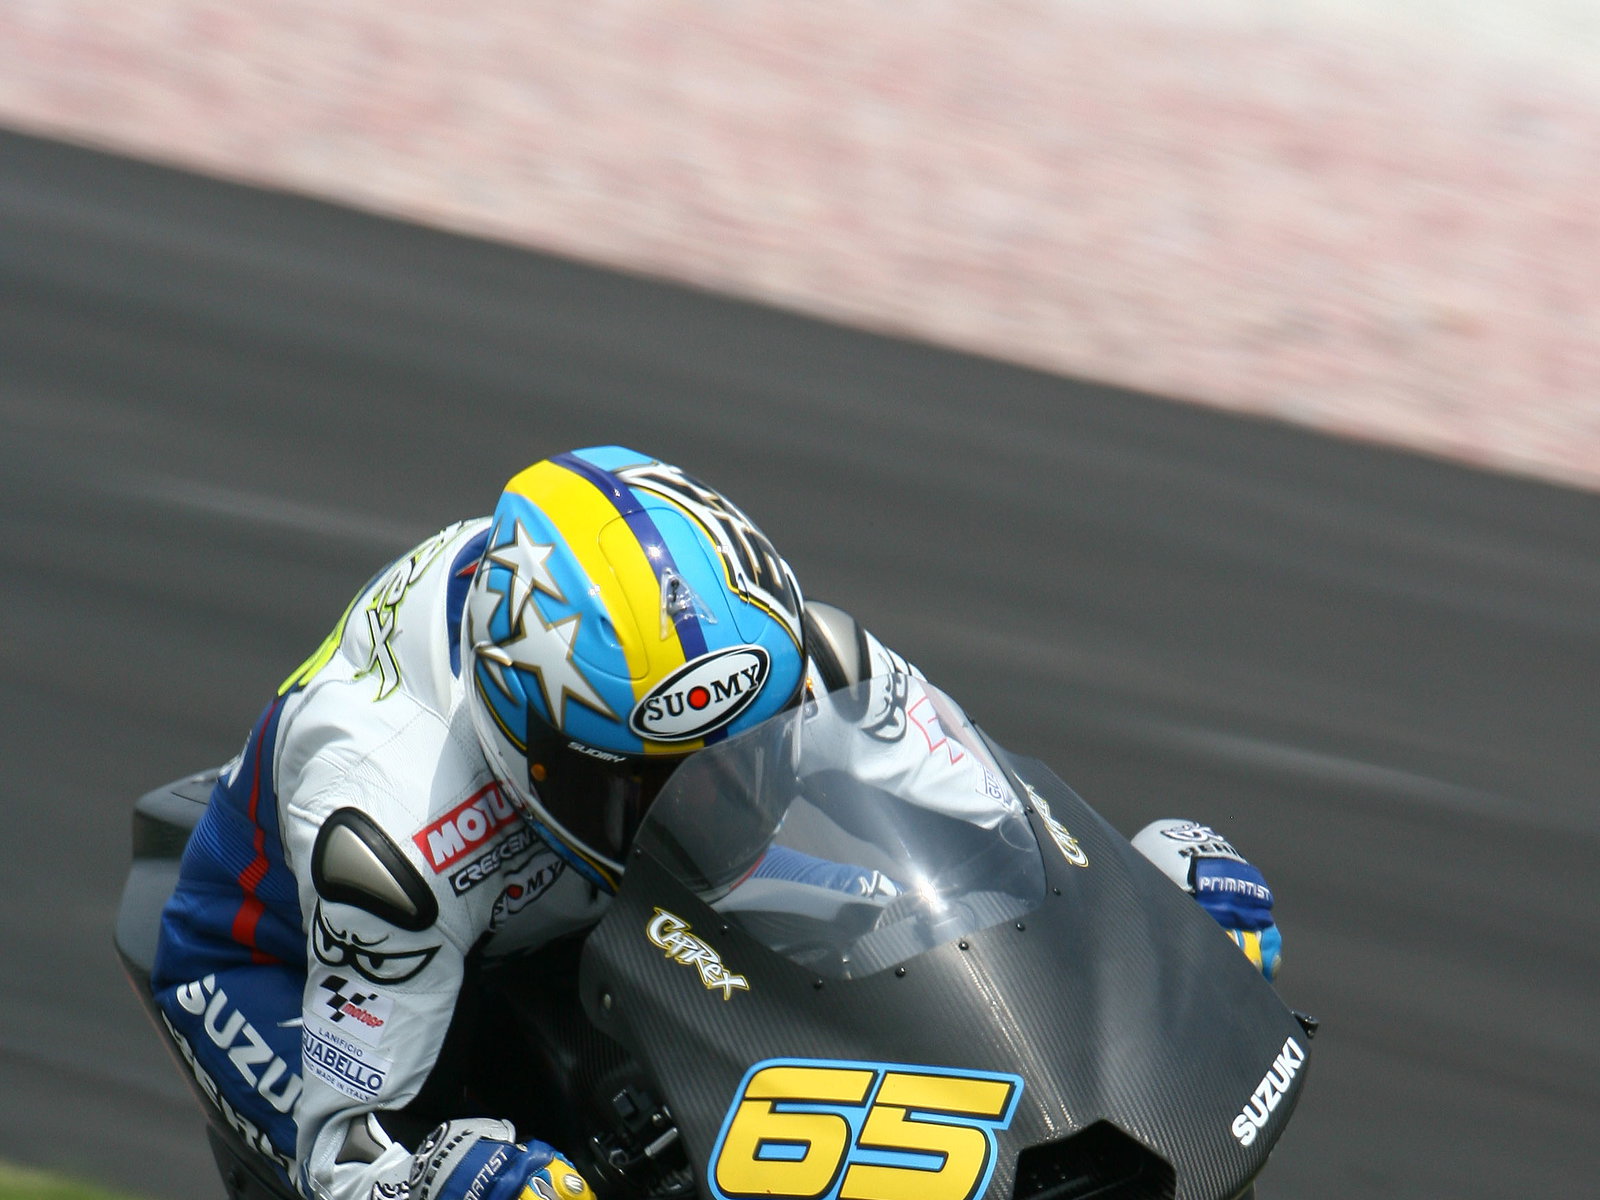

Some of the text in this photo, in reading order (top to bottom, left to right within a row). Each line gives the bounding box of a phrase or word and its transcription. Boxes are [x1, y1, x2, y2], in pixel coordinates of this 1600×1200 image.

[646, 664, 761, 721] SUOMY
[427, 789, 514, 867] MOTU
[455, 828, 538, 891] CRESCEN
[176, 973, 303, 1114] SUZU
[318, 1027, 364, 1058] LANIFICIO
[1231, 1036, 1306, 1148] SUZUKI
